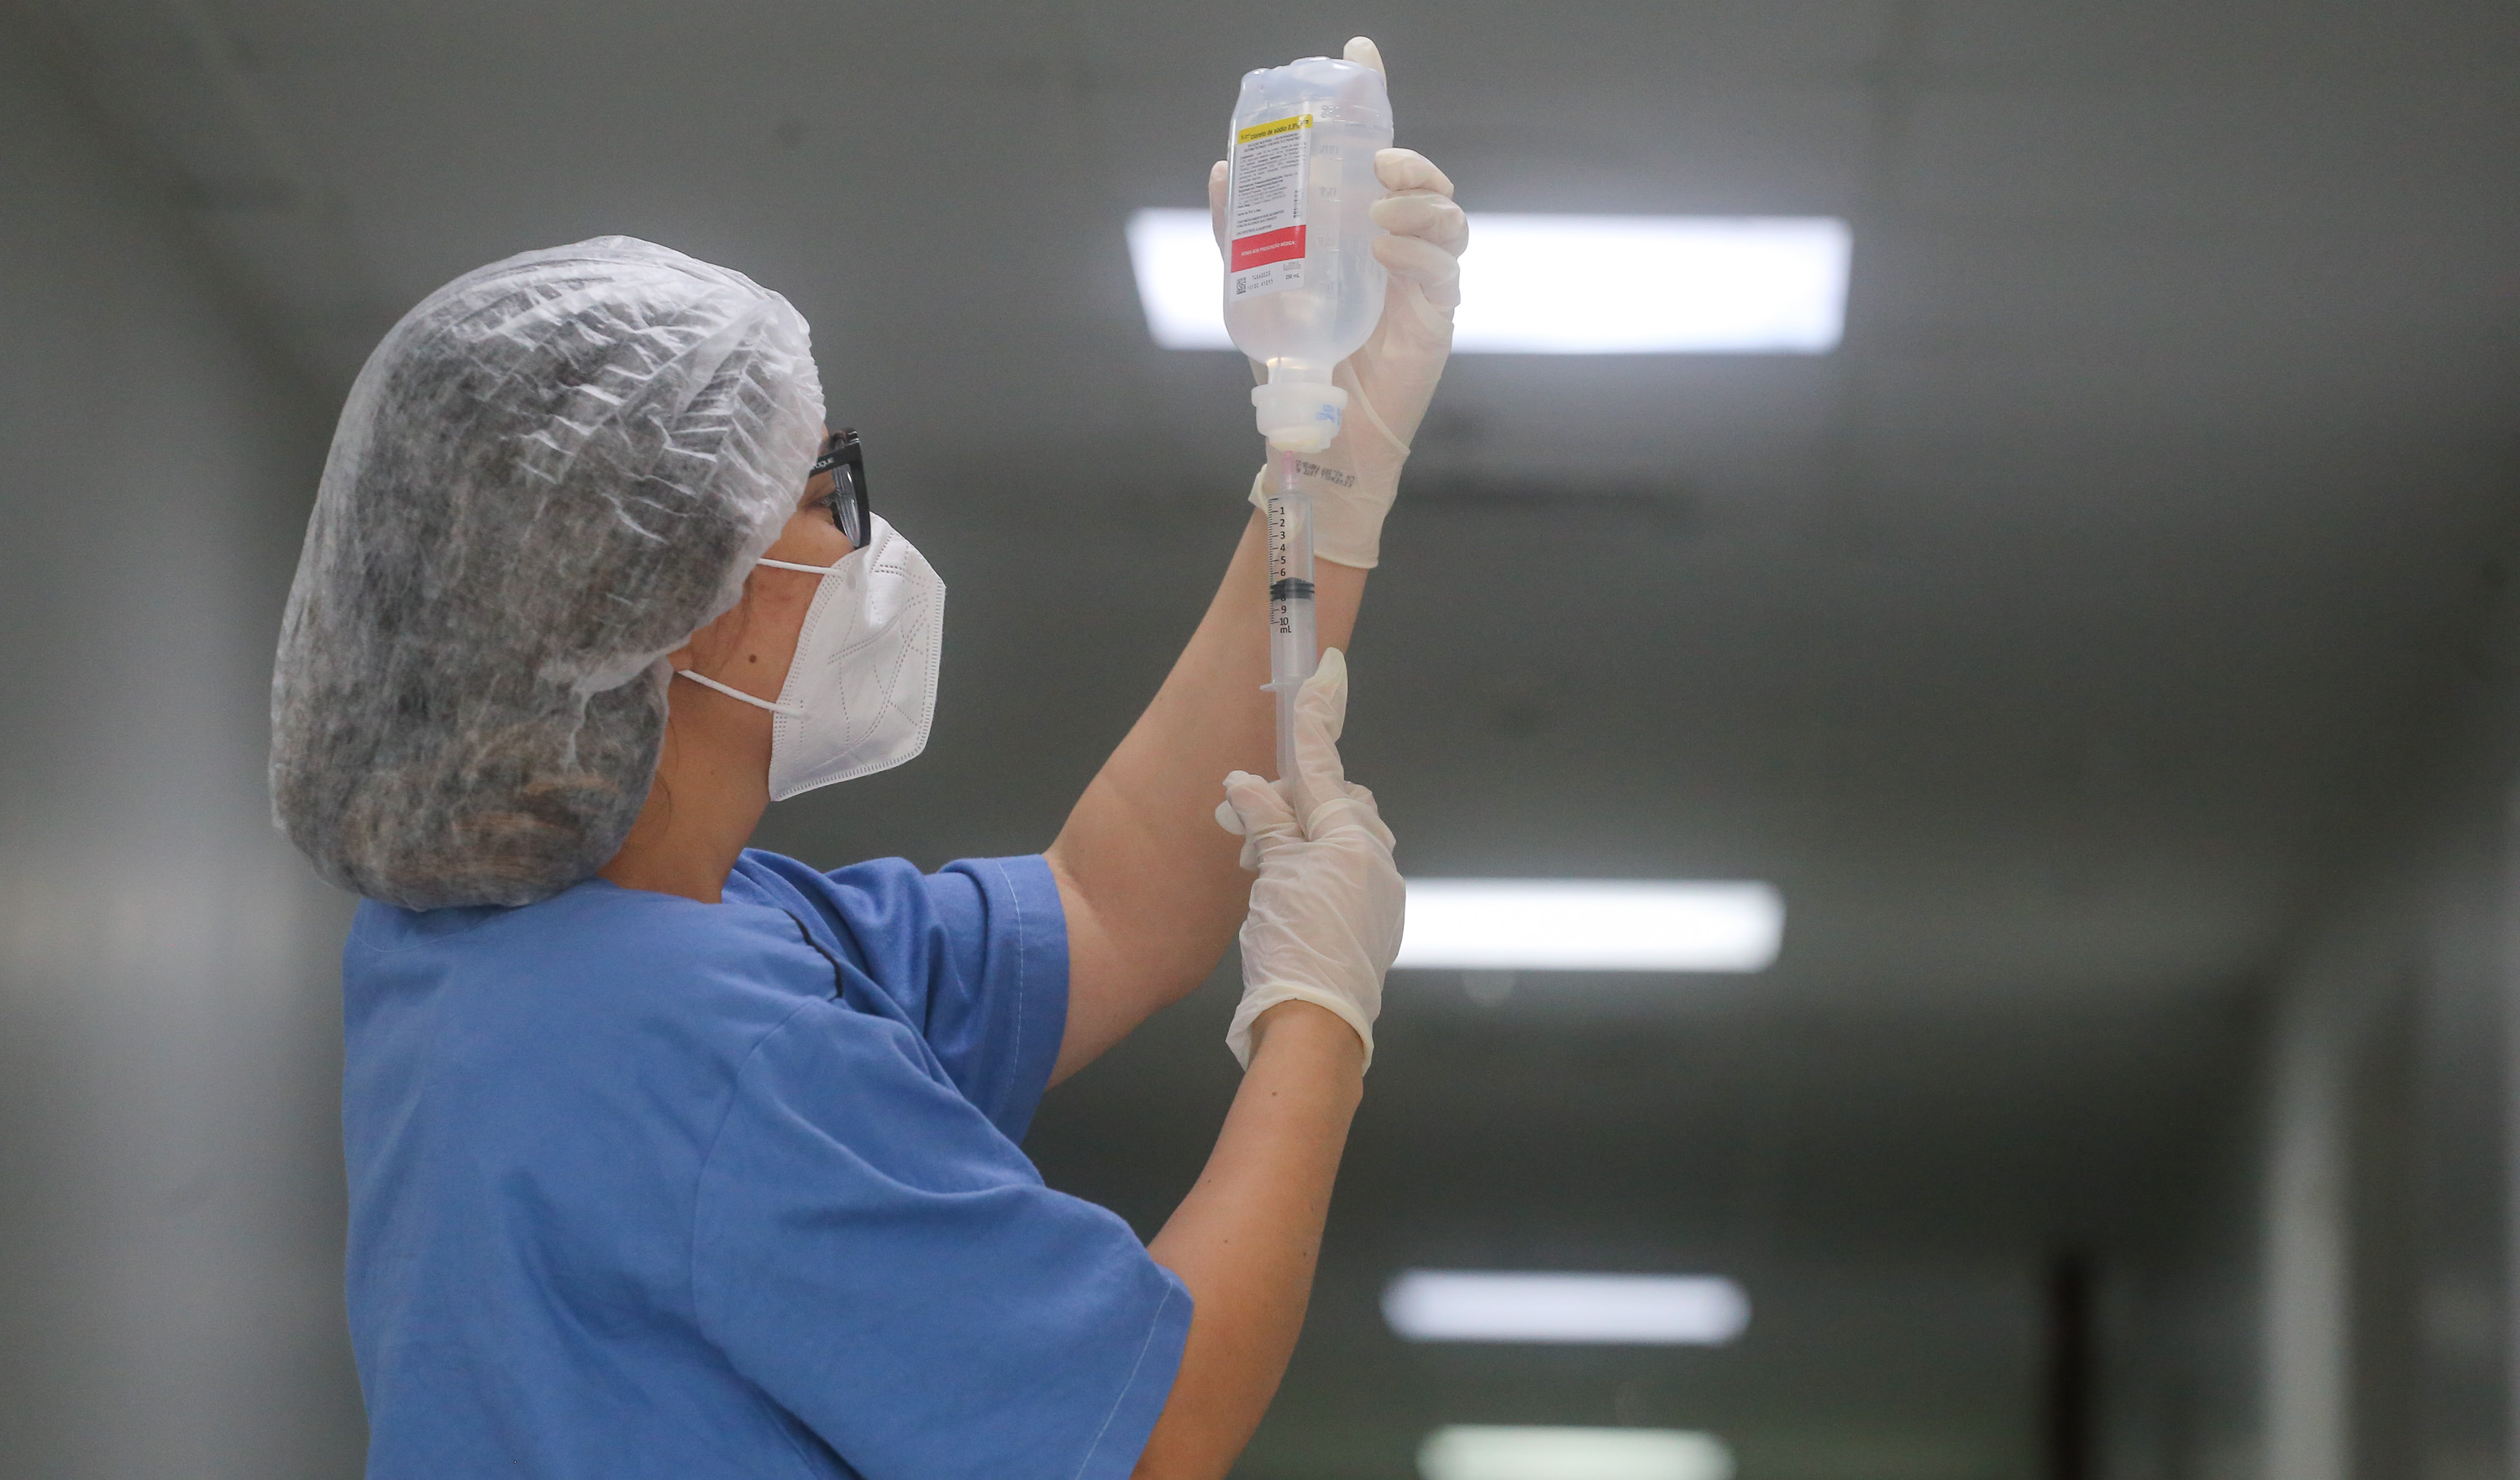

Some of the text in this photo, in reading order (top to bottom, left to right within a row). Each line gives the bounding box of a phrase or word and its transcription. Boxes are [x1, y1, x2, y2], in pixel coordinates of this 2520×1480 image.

[1279, 506, 1285, 515] 1
[1279, 518, 1285, 527] 2
[1279, 531, 1285, 539] 3
[1279, 543, 1286, 552] 4
[1280, 556, 1286, 564] 5
[1280, 568, 1286, 576] 6
[1281, 605, 1287, 614] 9
[1279, 617, 1289, 626] 10
[1280, 626, 1291, 634] mL
